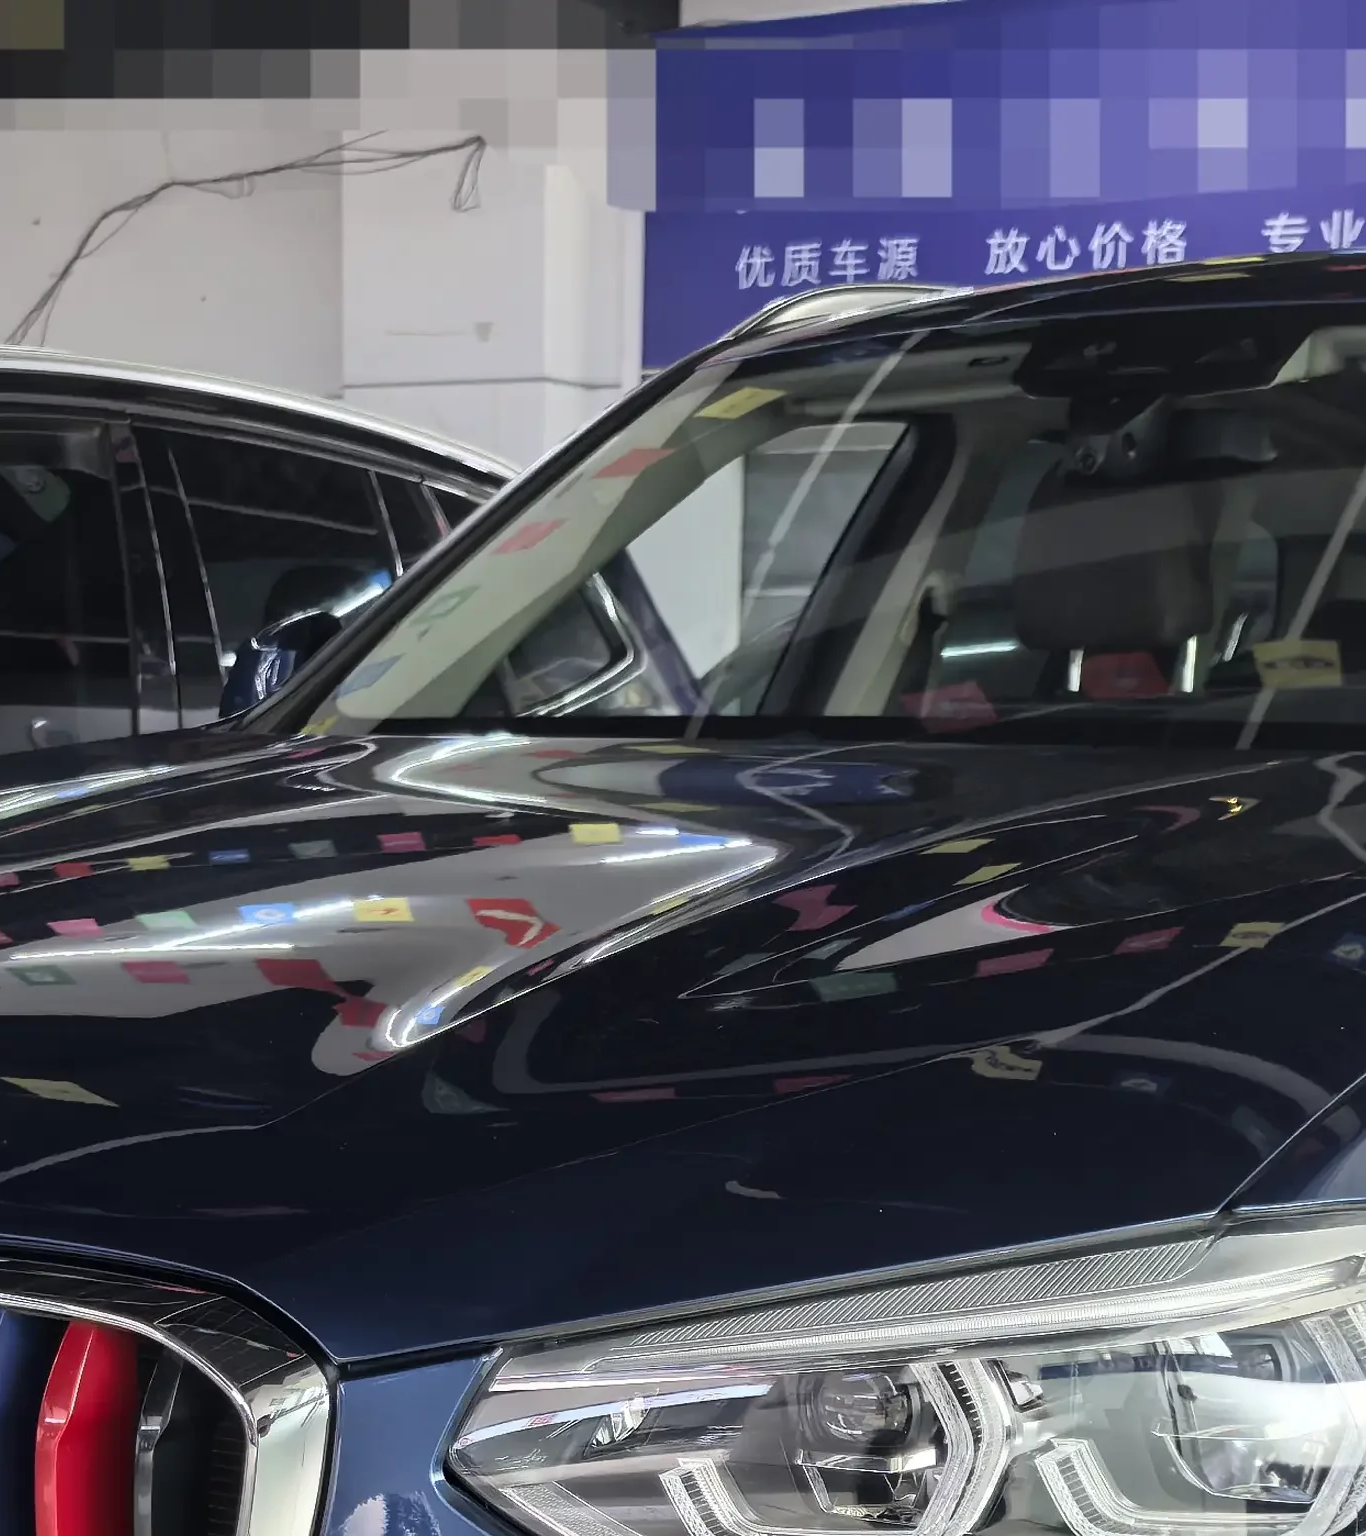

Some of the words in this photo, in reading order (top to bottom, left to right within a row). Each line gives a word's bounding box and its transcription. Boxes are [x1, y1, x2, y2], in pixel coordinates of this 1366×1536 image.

[736, 236, 919, 288] 优质车源
[984, 218, 1187, 275] 放心价格
